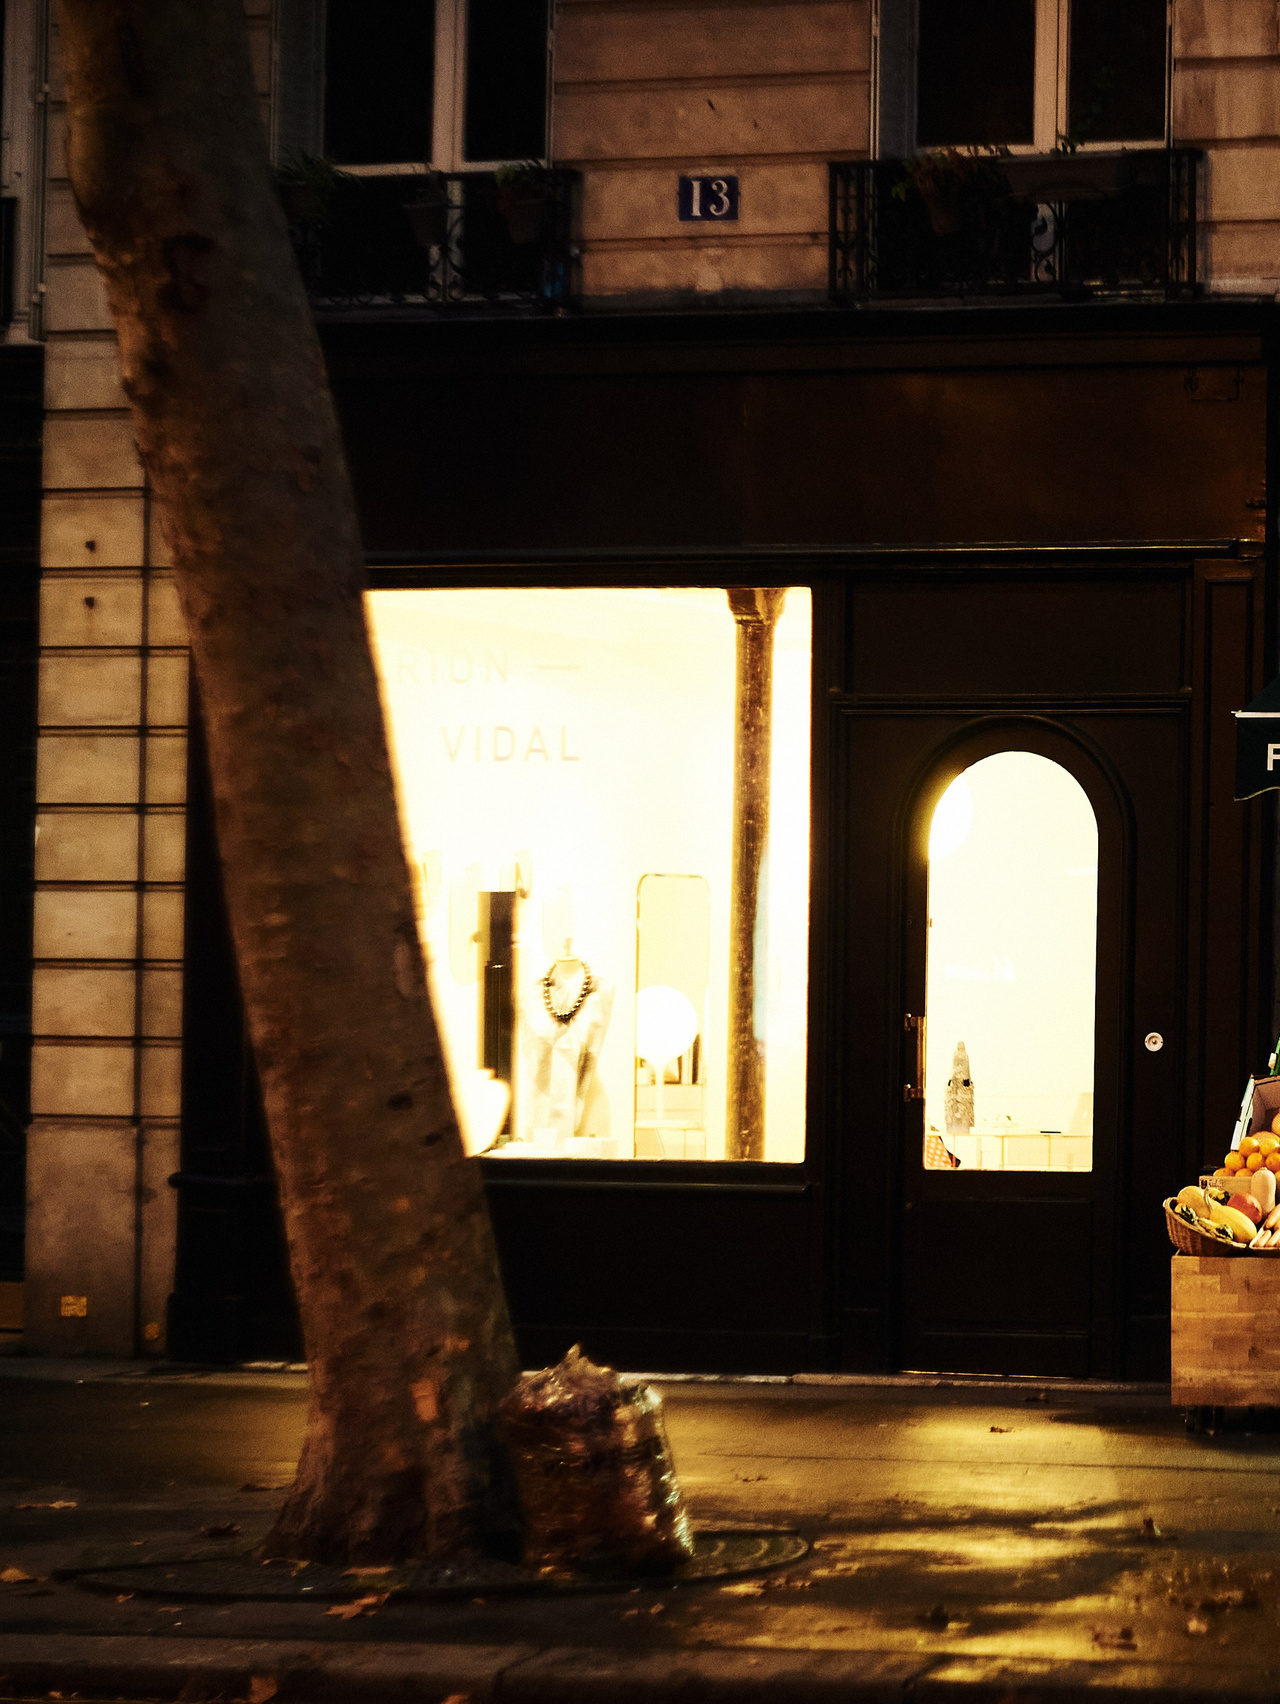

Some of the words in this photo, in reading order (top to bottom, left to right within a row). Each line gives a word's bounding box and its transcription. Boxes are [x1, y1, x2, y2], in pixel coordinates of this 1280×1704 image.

[691, 179, 731, 217] 13
[395, 647, 511, 685] RION
[440, 723, 581, 762] VIDAL
